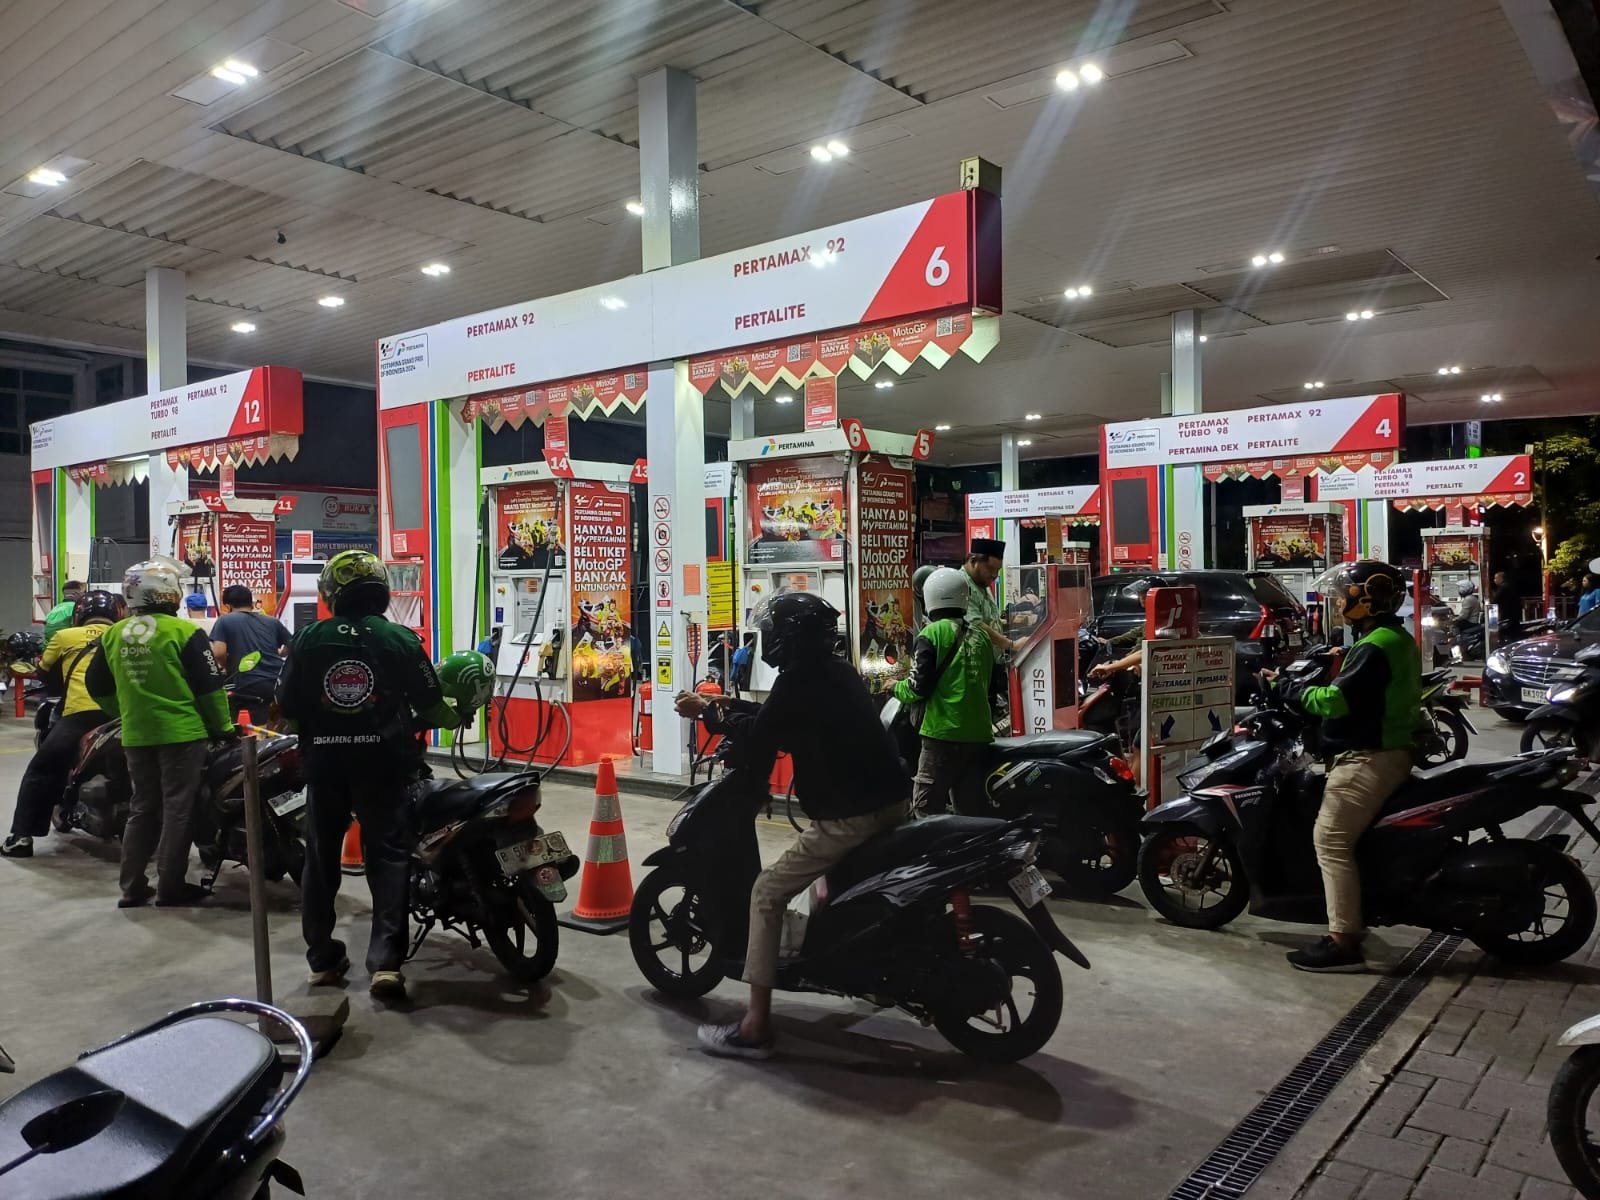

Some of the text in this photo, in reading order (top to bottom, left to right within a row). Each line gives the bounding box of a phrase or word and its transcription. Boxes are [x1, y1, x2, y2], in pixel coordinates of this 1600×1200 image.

[733, 237, 846, 278] PERTAMAX 92
[925, 246, 950, 287] 6
[734, 303, 806, 331] PERTALITE
[466, 312, 535, 338] PERTAMAX 92
[892, 322, 928, 337] MotoGP
[751, 350, 779, 362] MotoGP
[467, 362, 516, 383] PERTALITE
[187, 384, 227, 401] PERTAMAX 92
[150, 396, 178, 410] PERTAMAX
[150, 406, 179, 420] TURBO 98
[244, 399, 260, 425] 12
[1247, 408, 1322, 423] PERTAMAX 92
[1178, 417, 1229, 430] PERTAMAX
[1375, 418, 1392, 438] 4
[151, 427, 177, 440] PERTALITE
[849, 422, 862, 447] 6
[1178, 426, 1229, 438] TURBO 98
[778, 440, 815, 450] PERTAMINA
[919, 433, 930, 456] 5
[1168, 443, 1239, 456] PERTAMINA DEX
[1247, 438, 1299, 450] PERTALITE
[550, 456, 568, 471] 14
[1425, 464, 1466, 472] PERTAMAX
[634, 464, 648, 478] 13
[1374, 481, 1410, 489] PERTAMAX
[1513, 471, 1525, 486] 2
[1426, 482, 1463, 490] PERTALITE
[206, 495, 222, 506] 12
[278, 500, 293, 511] 11
[860, 507, 909, 521] HANYA DI
[573, 524, 626, 536] HANYA DI
[861, 519, 909, 533] MyPERTAMINA
[574, 534, 626, 545] MyPERTAMINA
[861, 534, 909, 548] BELI TIKET
[221, 545, 272, 553] HANYA DI
[574, 546, 627, 557] BELI TIKET
[861, 549, 907, 564] MotoGP
[222, 561, 272, 569] BELI TIKET
[574, 558, 624, 571] MotoGP
[222, 569, 270, 579] MotoGP
[574, 571, 626, 583] BANYAK
[861, 565, 909, 579] BANYAK
[222, 579, 272, 588] BANYAK
[575, 583, 627, 592] UNTUNGNYA
[862, 579, 910, 590] UNTUNGNYA
[120, 645, 152, 658] gojek
[1033, 668, 1046, 707] SELF
[1034, 716, 1047, 735] SE
[353, 734, 381, 744] BERSATU
